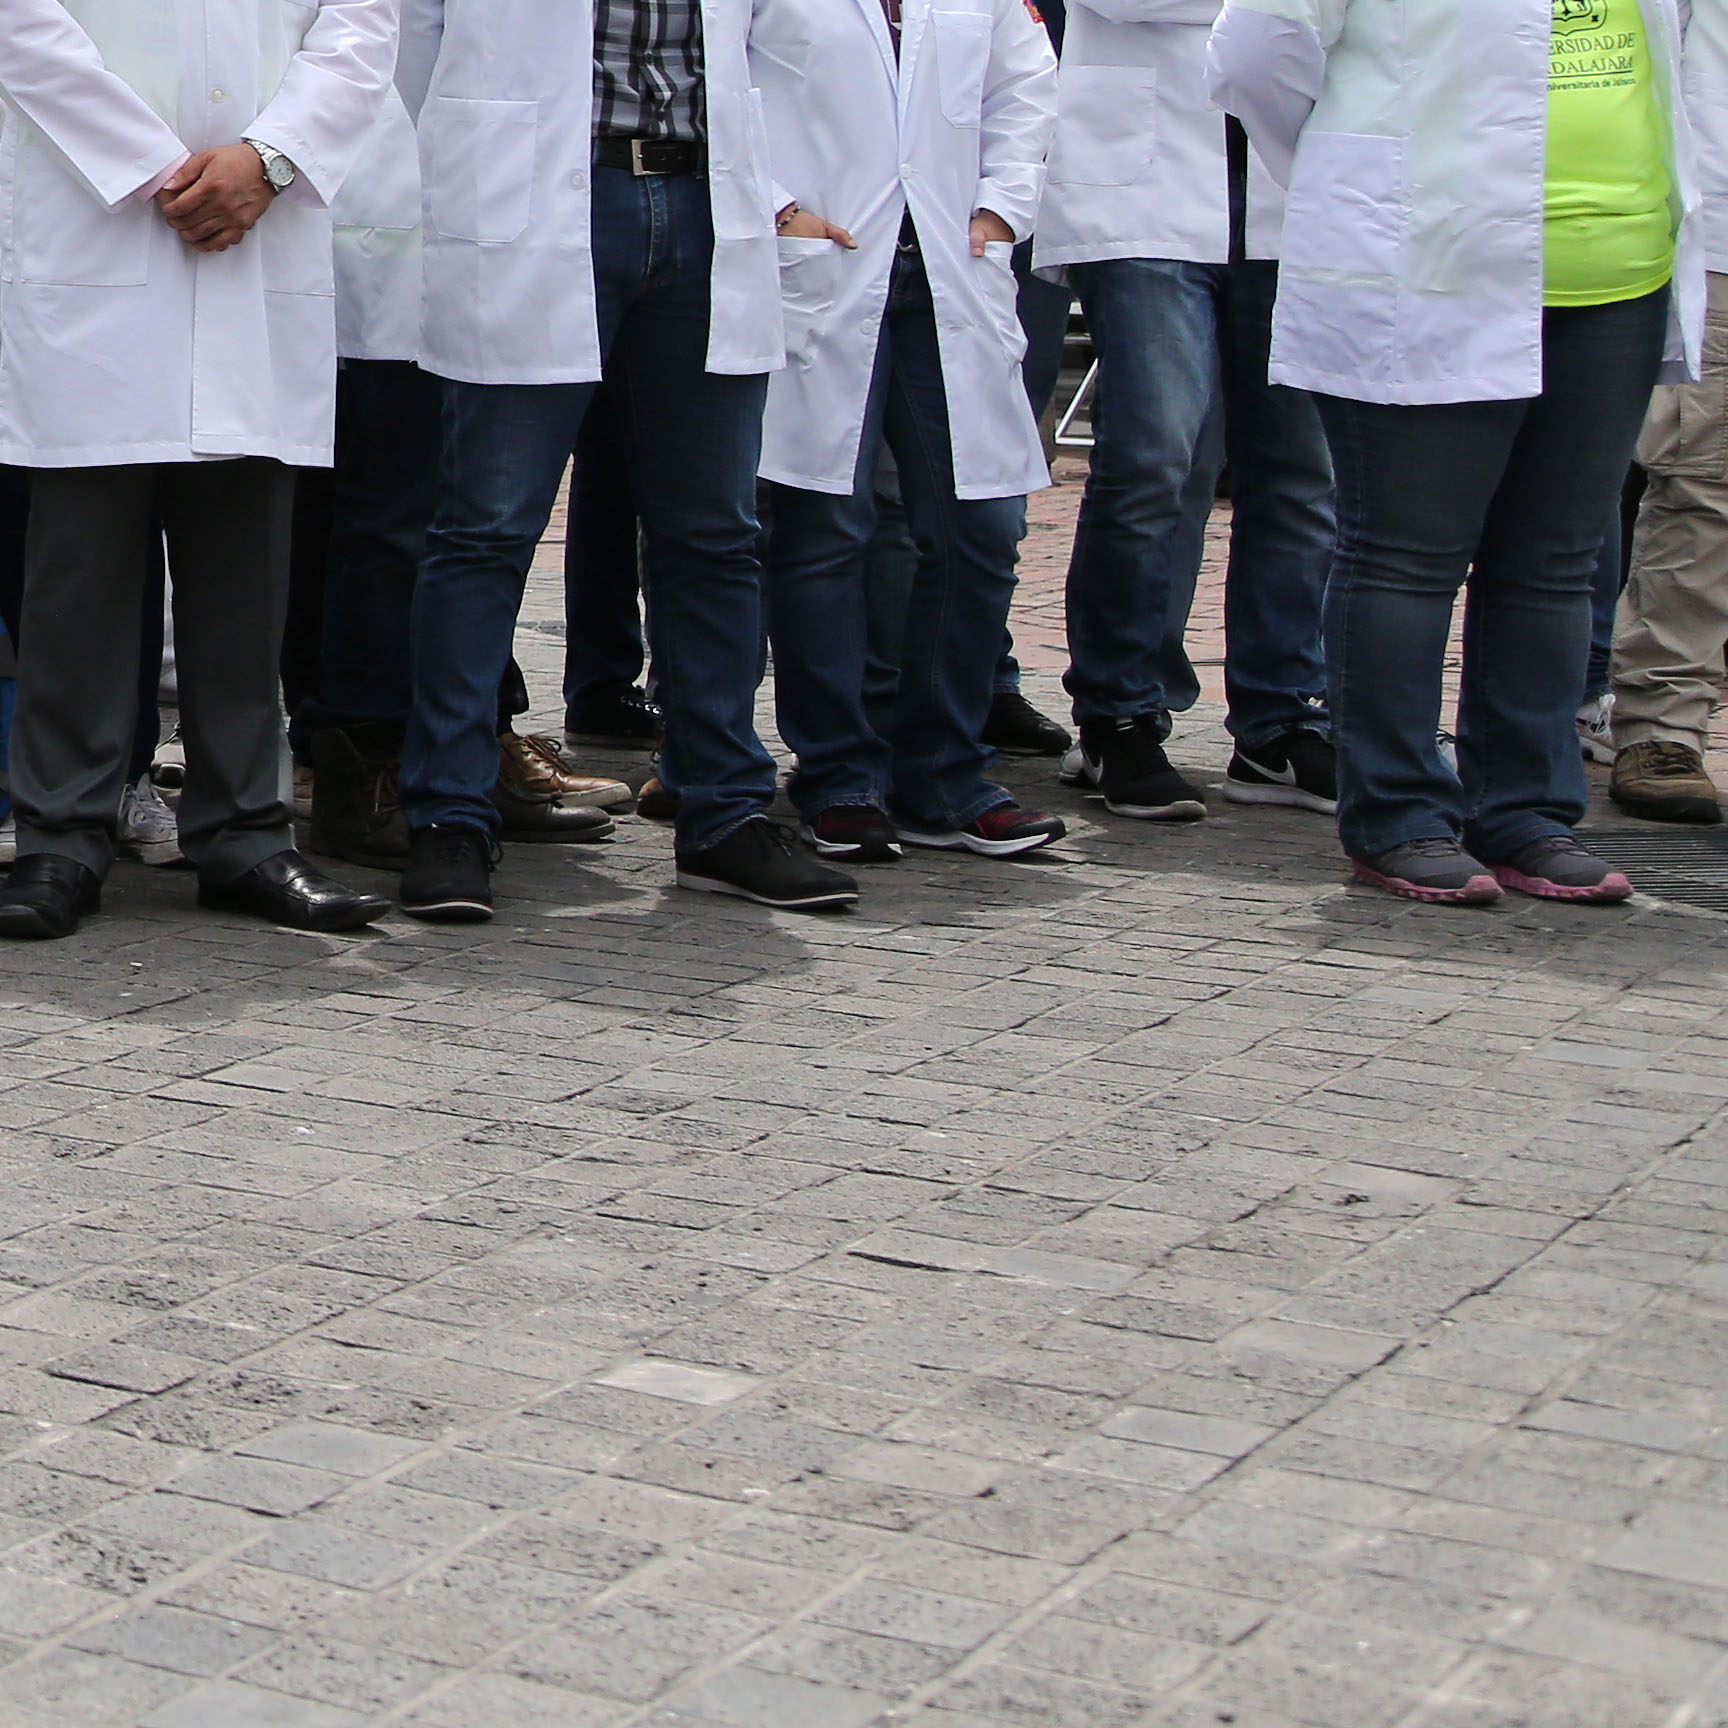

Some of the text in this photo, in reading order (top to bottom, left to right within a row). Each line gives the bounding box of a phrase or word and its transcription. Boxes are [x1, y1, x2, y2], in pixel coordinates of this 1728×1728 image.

[1548, 32, 1636, 55] ERSIDAD DE
[1547, 55, 1633, 75] DALAJARA
[1546, 79, 1600, 91] niversitaria
